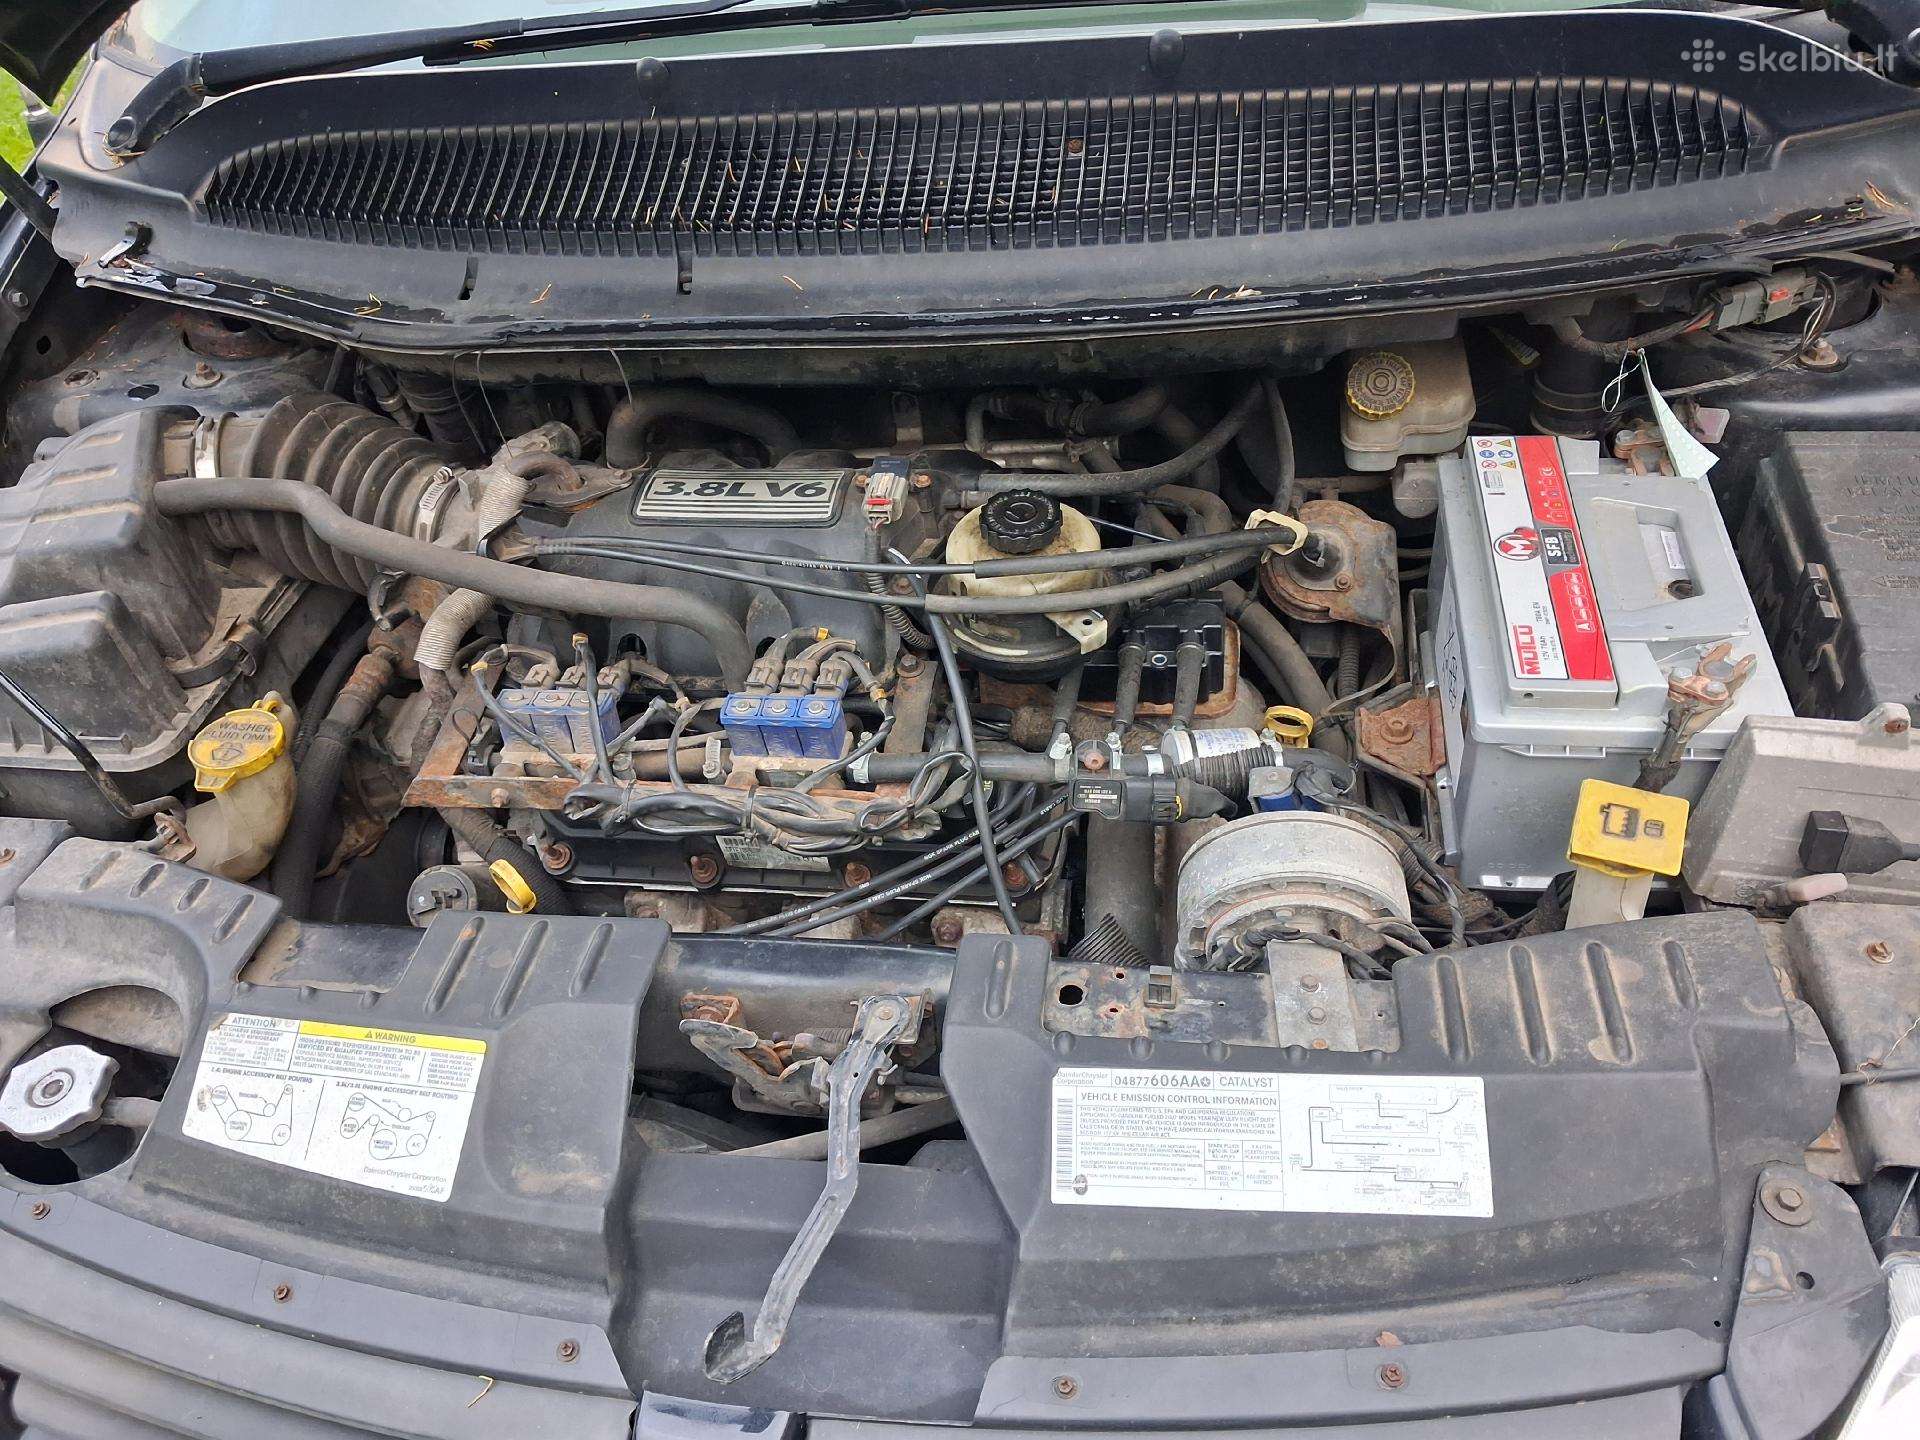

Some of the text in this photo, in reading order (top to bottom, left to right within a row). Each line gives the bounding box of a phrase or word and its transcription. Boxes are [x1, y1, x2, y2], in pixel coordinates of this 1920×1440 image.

[653, 481, 827, 498] 3.8L V6
[1545, 536, 1562, 557] SFB
[1513, 624, 1541, 675] MUTLU
[218, 721, 272, 733] WASHER
[232, 1017, 276, 1028] ATTENTION
[374, 1032, 416, 1044] WARNING
[1114, 1074, 1200, 1087] 04877606AA
[1219, 1076, 1273, 1088] CATALYST
[1081, 1092, 1277, 1106] VEHICLE EMISSION CONTROL INFORMATION
[412, 1172, 447, 1183] Corporation
